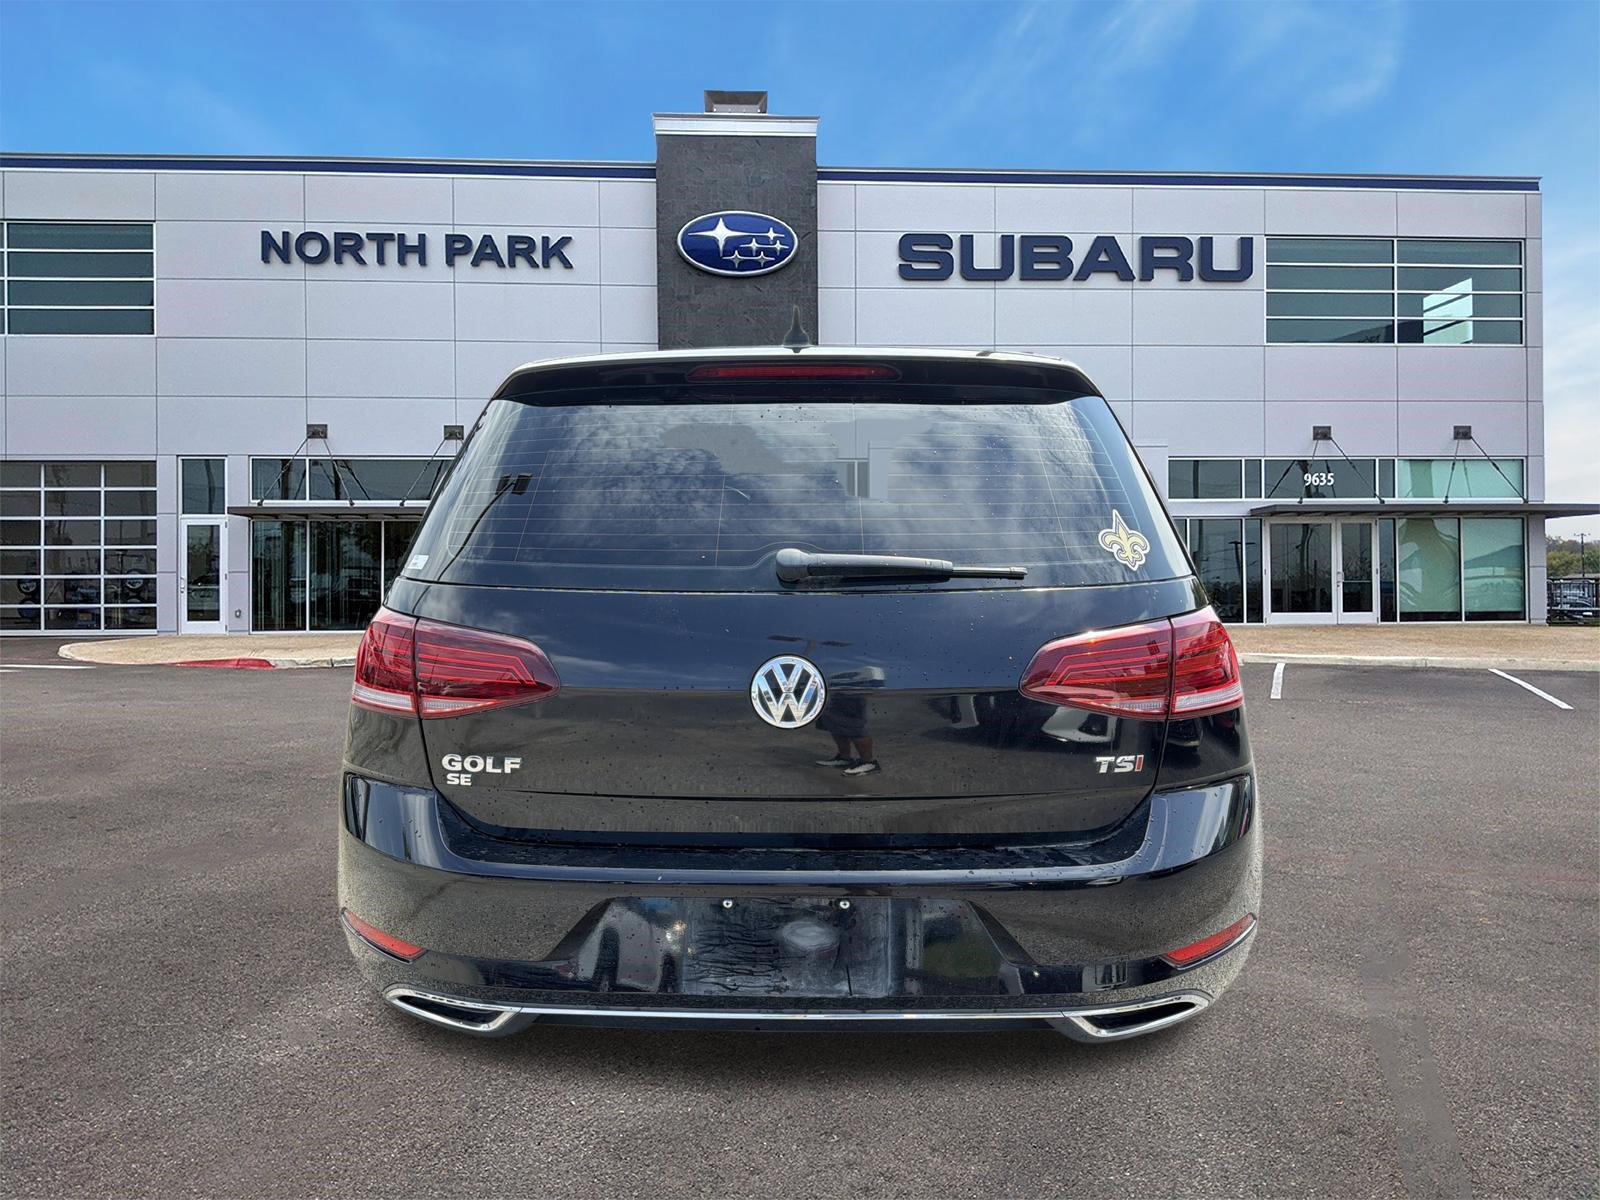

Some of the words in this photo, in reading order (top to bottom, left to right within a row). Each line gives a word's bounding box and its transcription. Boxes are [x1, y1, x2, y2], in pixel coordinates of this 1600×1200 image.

[261, 230, 427, 267] NORTH
[444, 233, 574, 269] PARK
[898, 233, 1254, 282] SUBARU
[1303, 472, 1335, 486] 9635
[754, 659, 821, 725] VW
[441, 753, 522, 774] GOLF
[1095, 754, 1145, 774] TSI
[446, 773, 472, 786] SE
